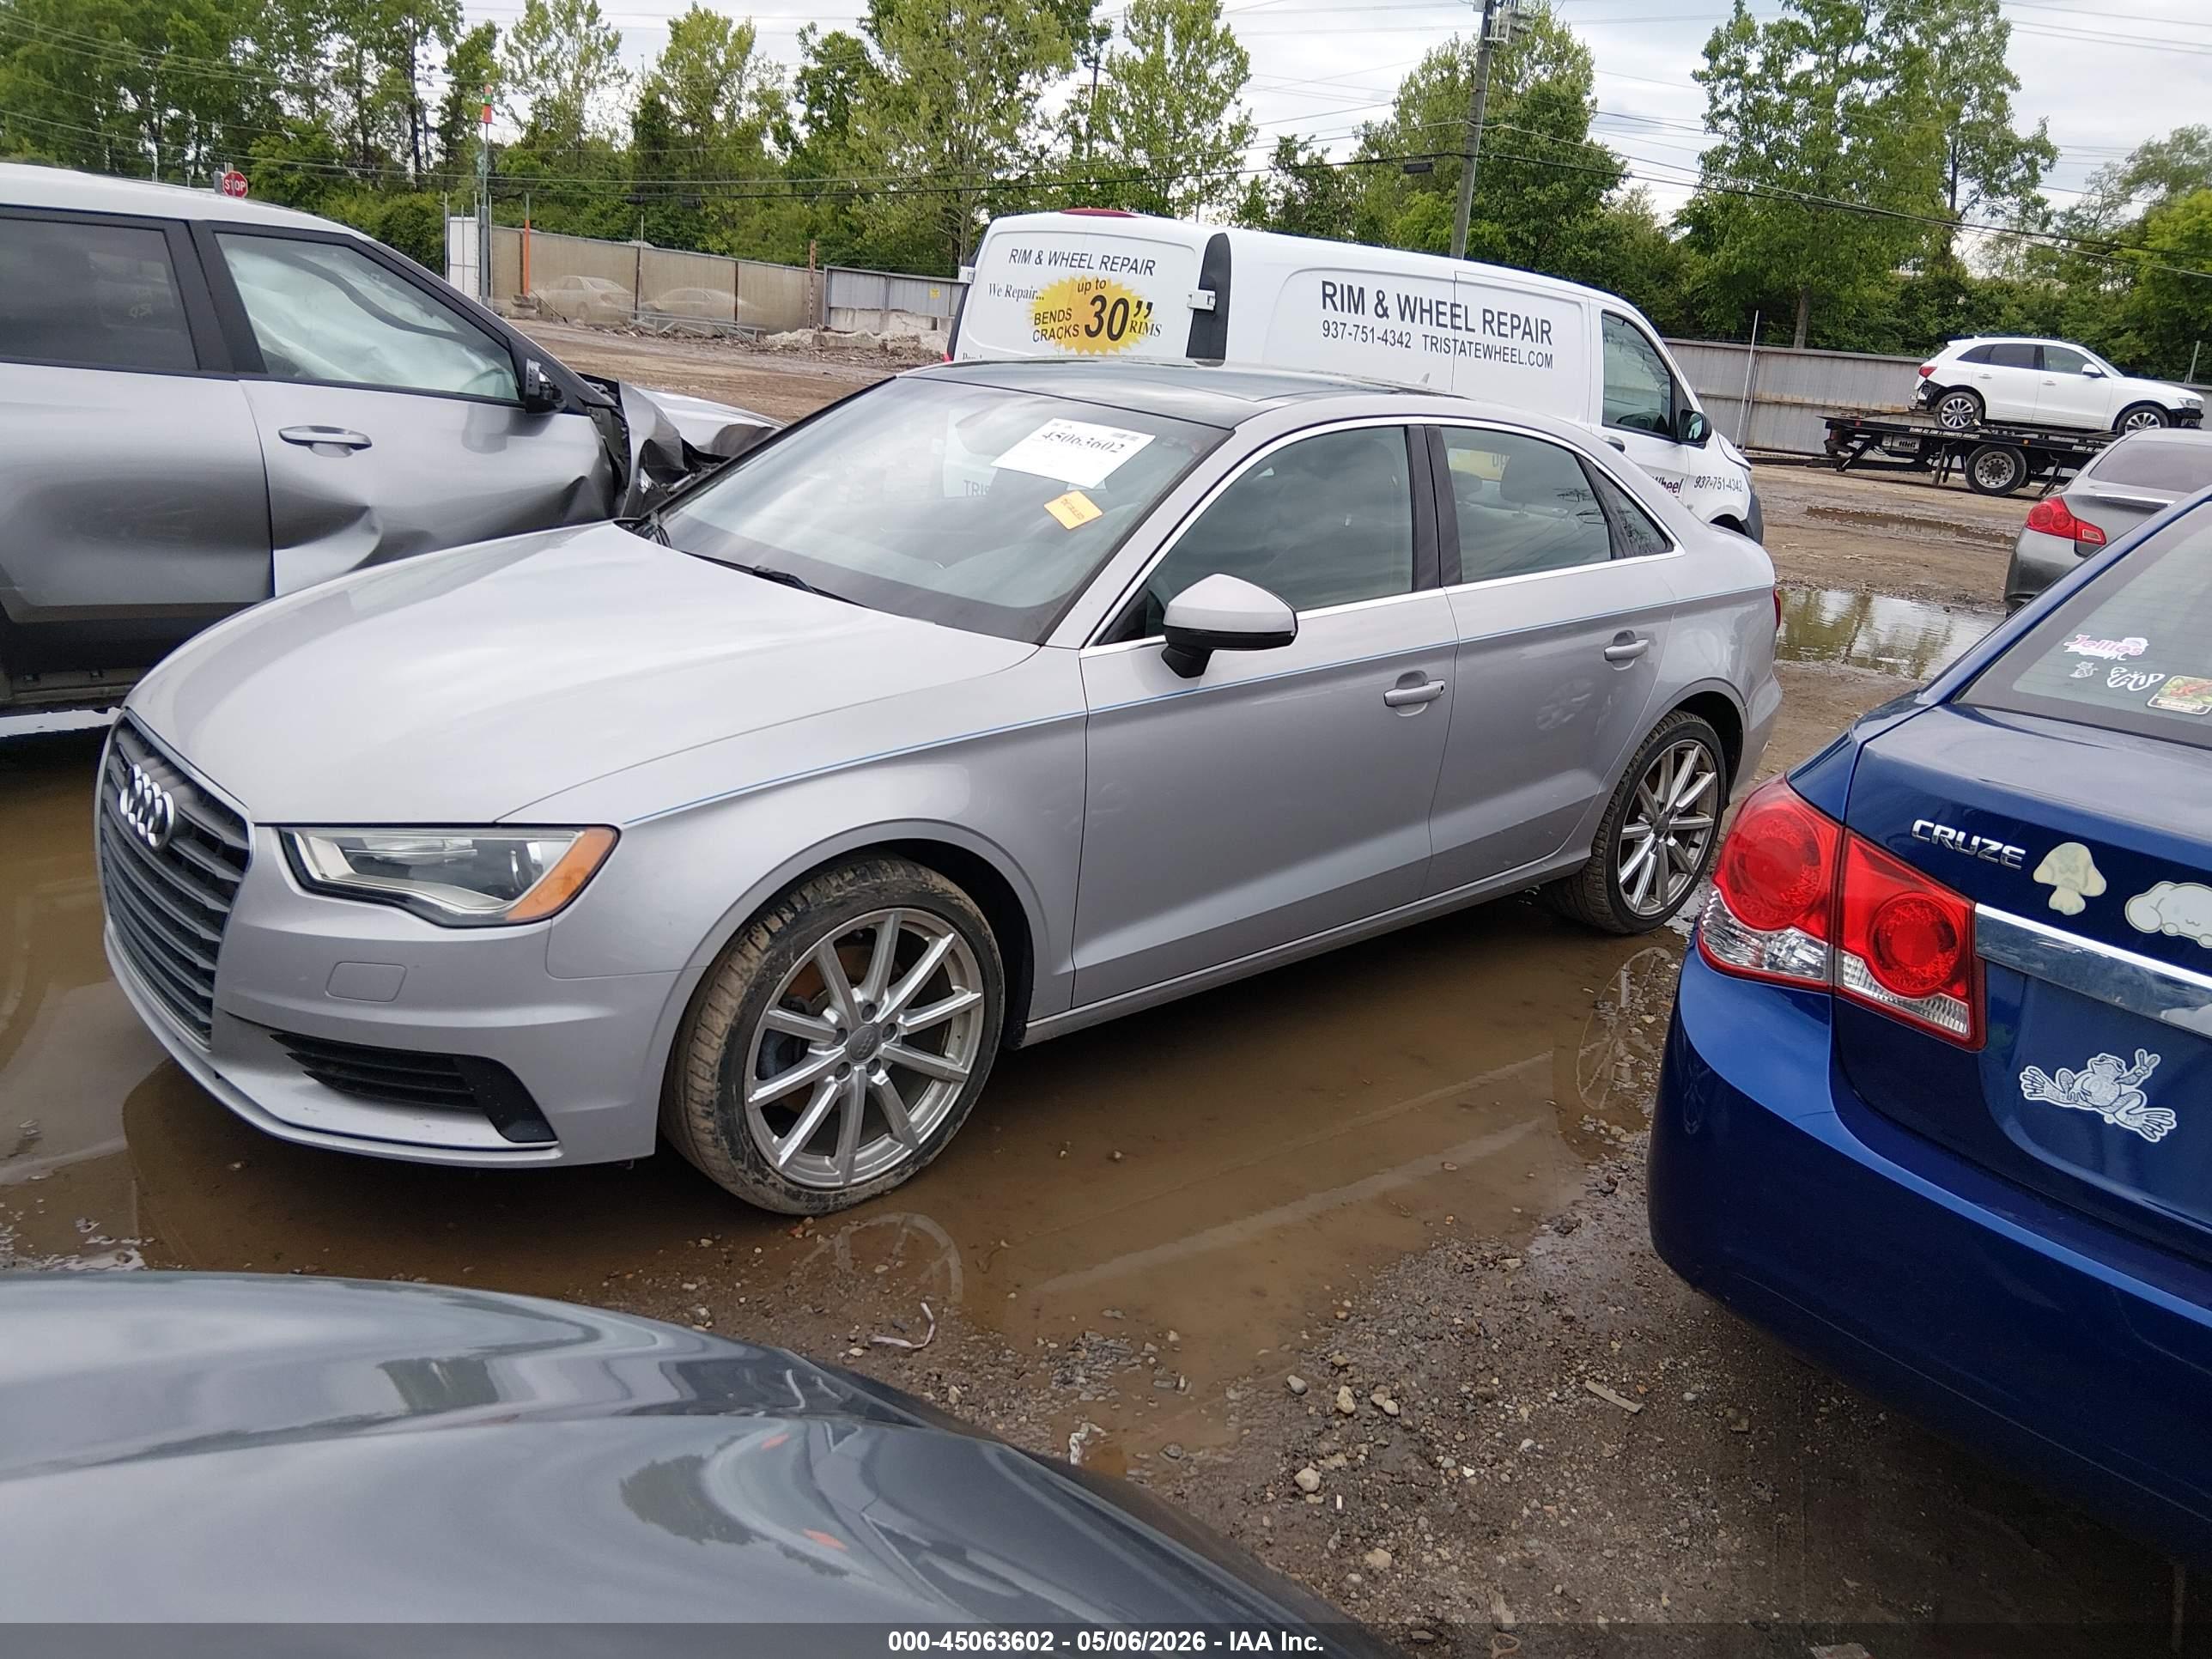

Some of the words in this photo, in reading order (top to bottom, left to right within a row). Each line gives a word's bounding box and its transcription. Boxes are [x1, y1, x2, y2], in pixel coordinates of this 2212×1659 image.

[224, 179, 246, 191] STOP
[1008, 248, 1033, 265] RIM
[1034, 251, 1044, 265] &
[1048, 250, 1095, 270] WHEEL
[1100, 254, 1156, 276] REPAIR
[988, 282, 1003, 297] We
[1077, 282, 1092, 295] up
[1095, 277, 1107, 291] to
[1033, 307, 1073, 325] BENDS
[1321, 280, 1365, 316] RIM
[1374, 289, 1389, 320] &
[1397, 294, 1476, 333] WHEEL
[1482, 308, 1553, 346] REPAIR
[1032, 323, 1079, 343] CRACKS
[1128, 319, 1162, 337] RIMS
[1322, 319, 1412, 349] 937-751-4342
[1422, 334, 1553, 369] TRISTATEWHEEL.COM
[1693, 475, 1743, 493] 937-751-4342
[1911, 819, 2027, 870] CRUZE
